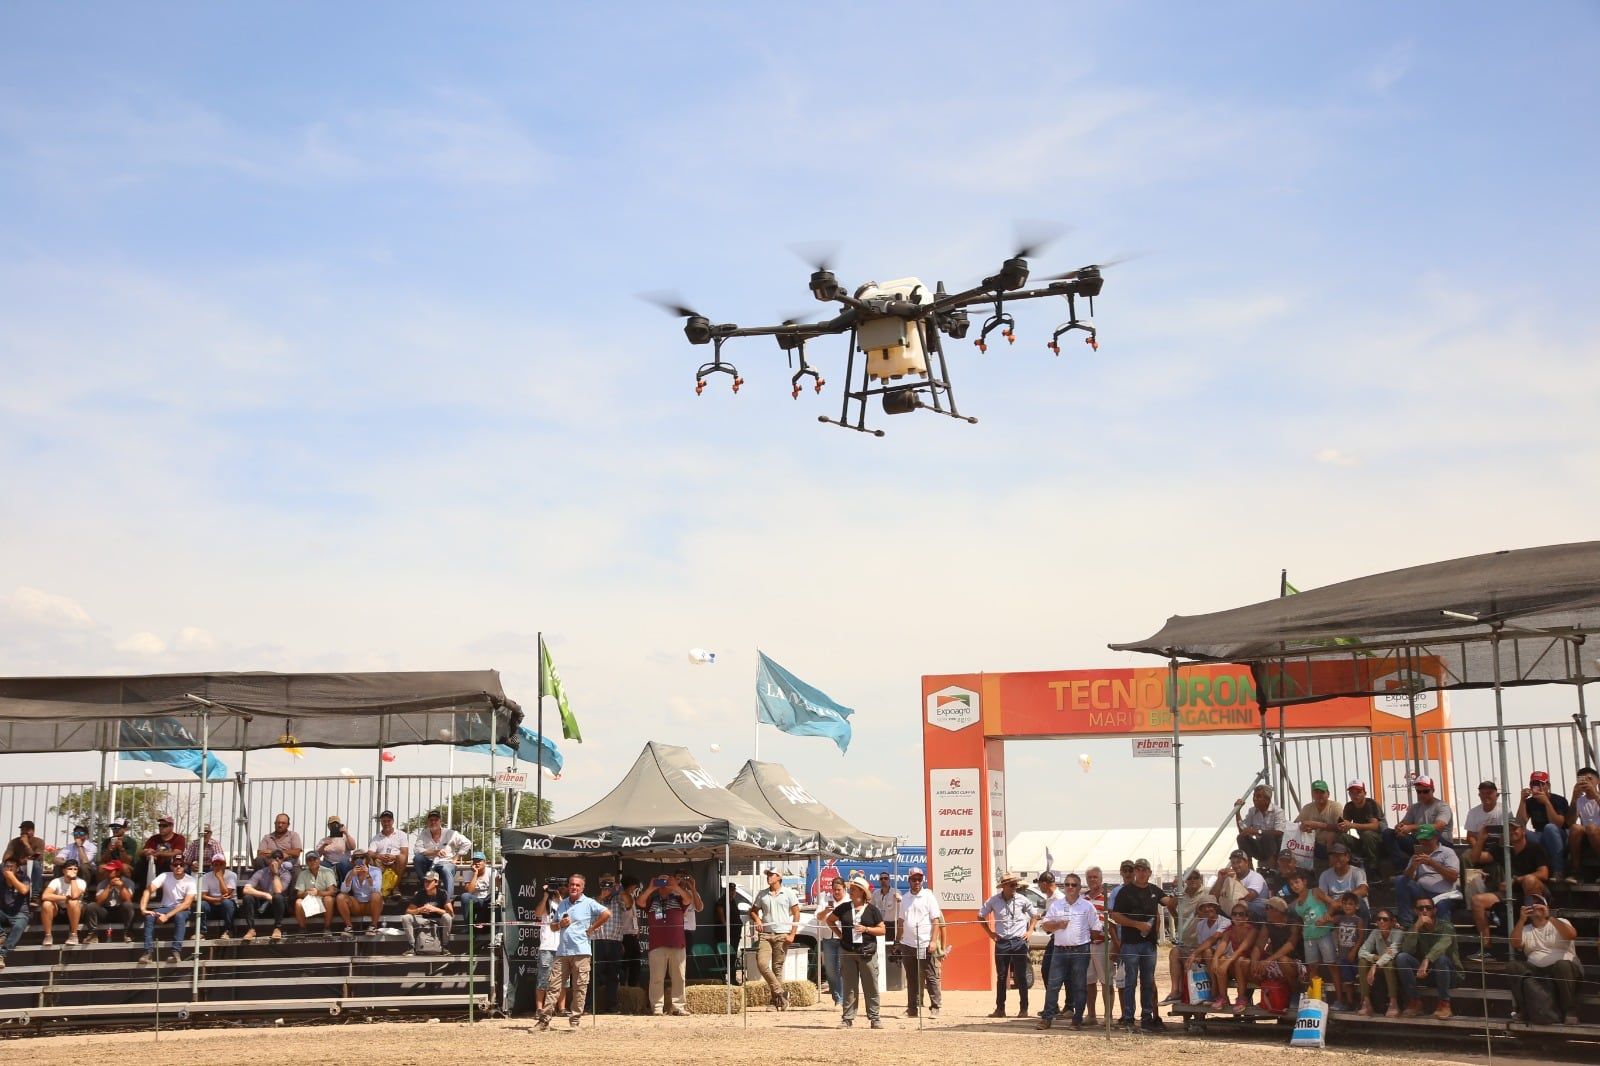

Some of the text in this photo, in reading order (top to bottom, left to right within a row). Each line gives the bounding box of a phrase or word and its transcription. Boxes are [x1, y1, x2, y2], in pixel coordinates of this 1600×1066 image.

[1386, 694, 1427, 702] Expogro
[936, 708, 971, 717] Expoagro
[1089, 711, 1144, 728] MARIO
[939, 808, 974, 816] APACHE
[672, 831, 703, 845] AKO
[940, 829, 974, 837] CLAAS
[522, 838, 552, 850] AKO
[573, 838, 600, 849] AKO
[621, 835, 651, 848] AKO
[947, 847, 975, 856] jacto
[518, 885, 536, 898] AKO
[517, 906, 537, 920] Para
[517, 944, 529, 956] de
[1195, 980, 1212, 991] OM
